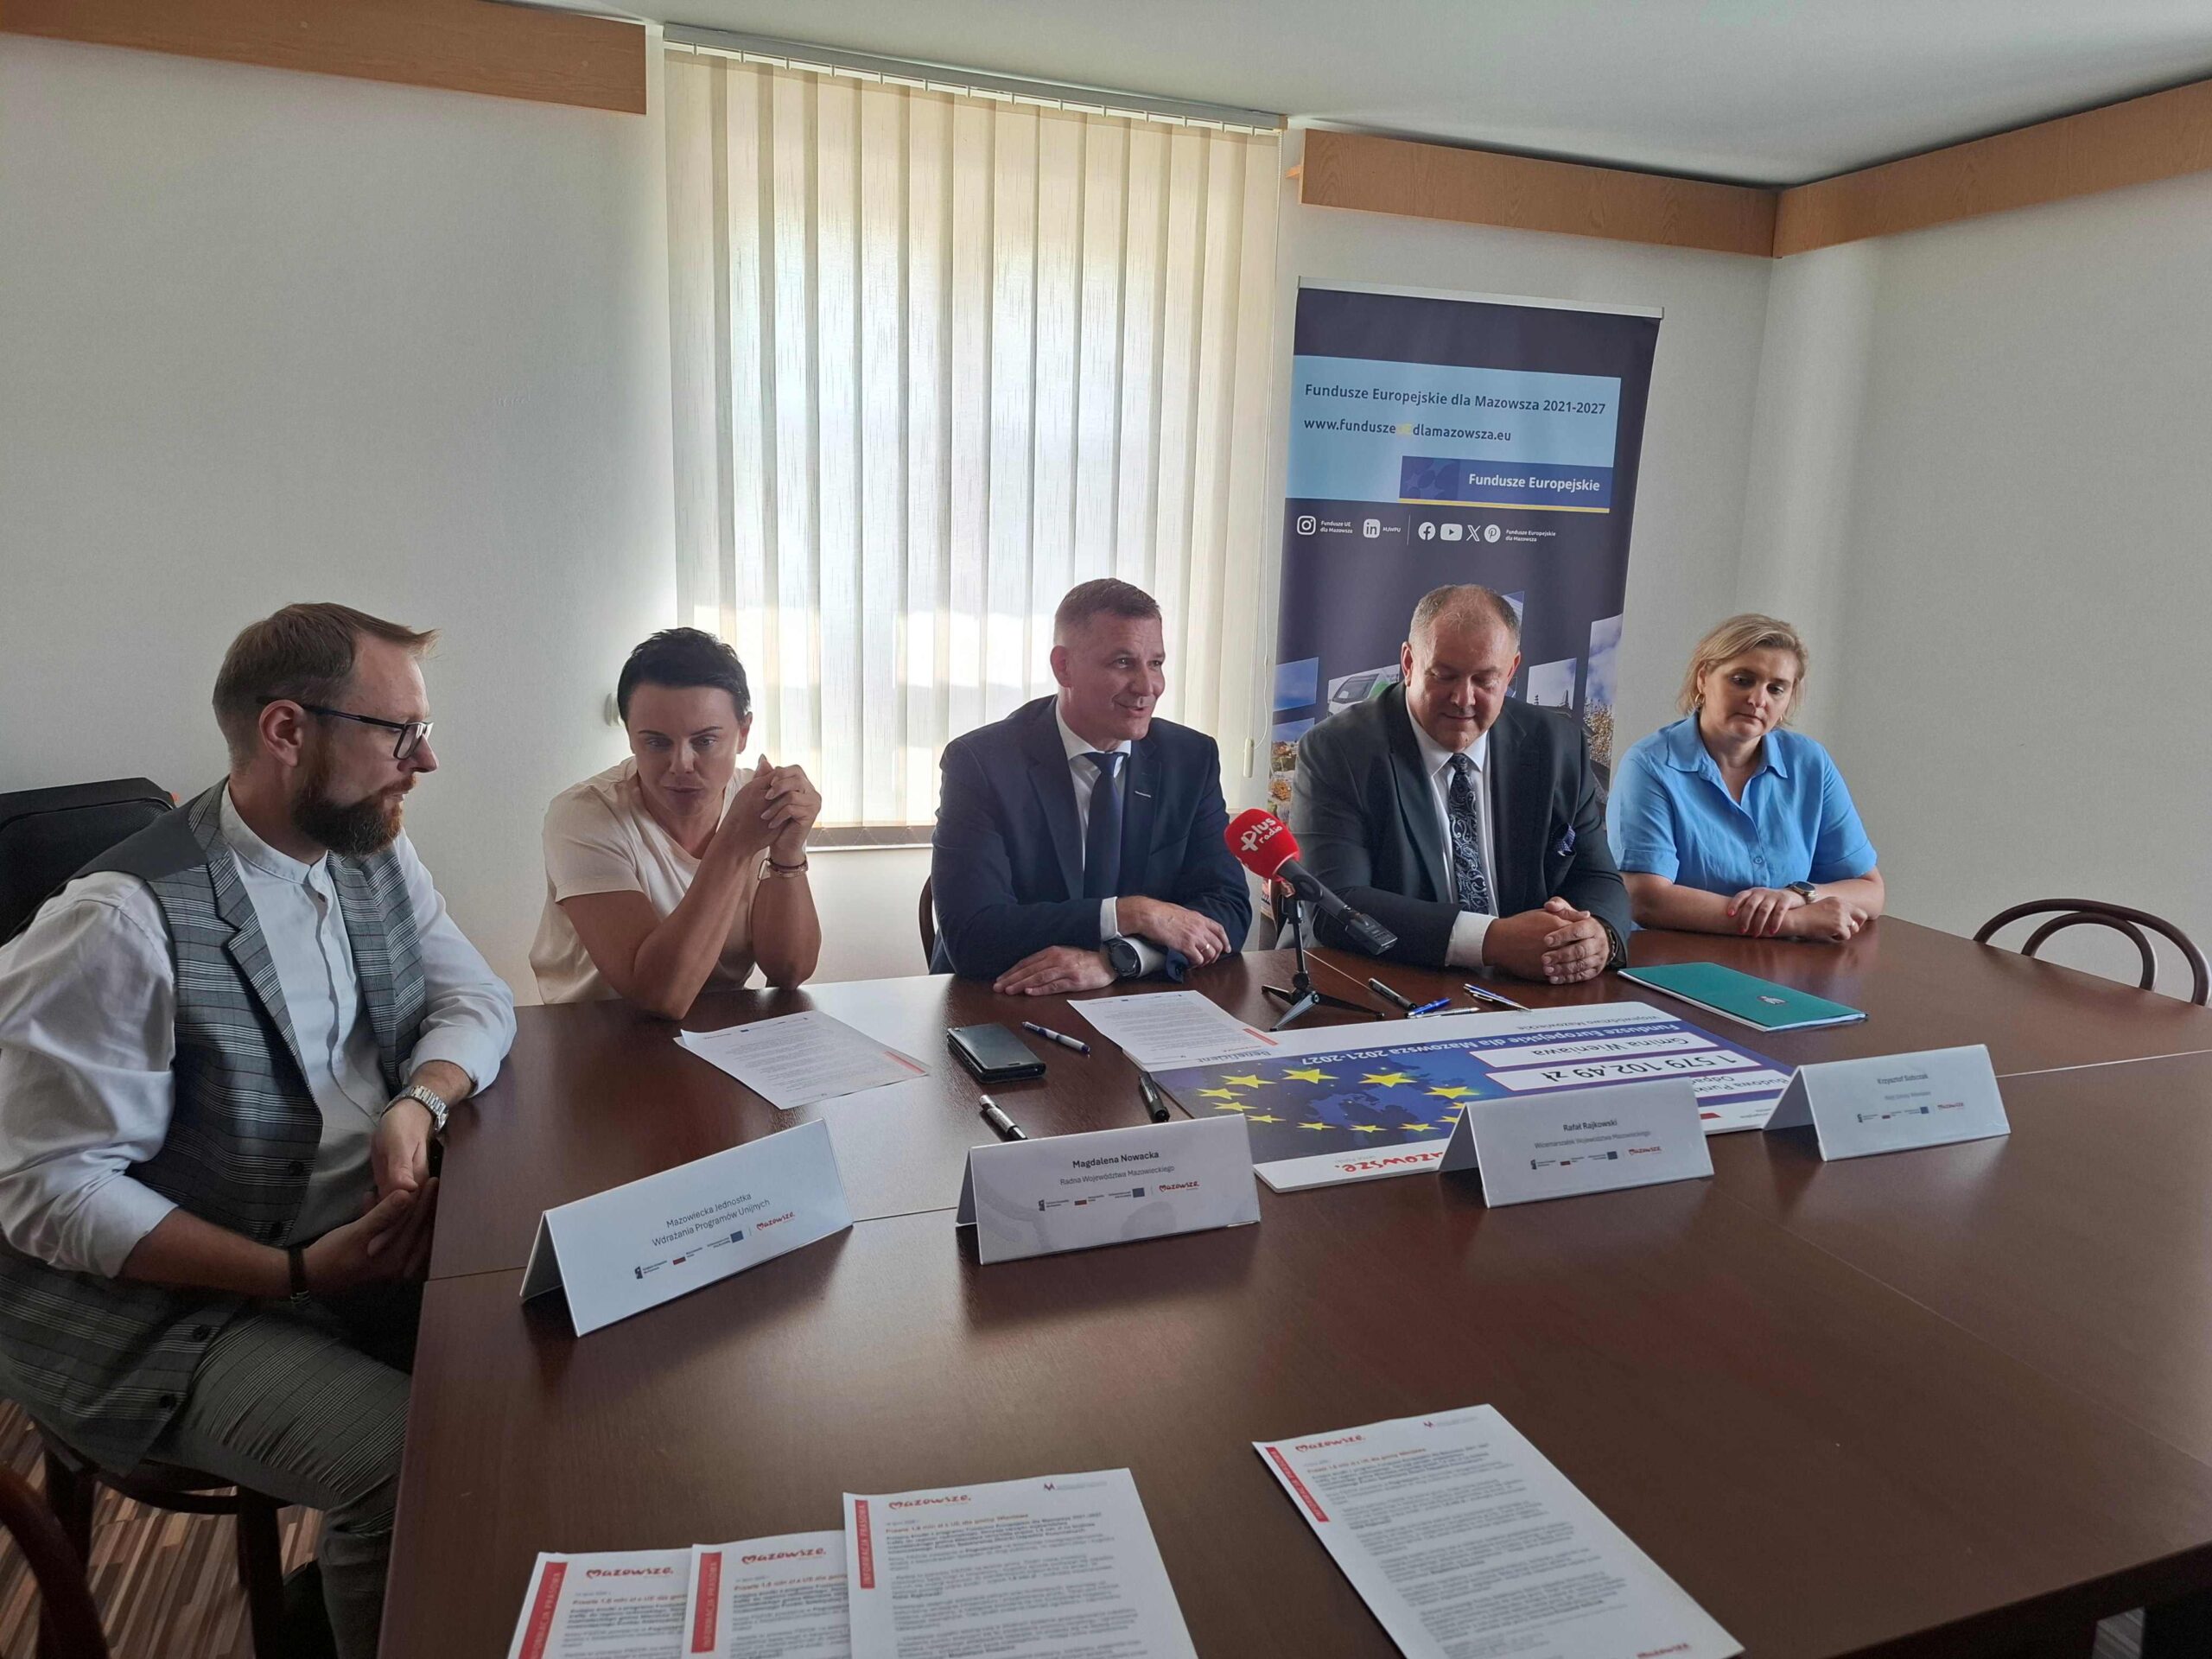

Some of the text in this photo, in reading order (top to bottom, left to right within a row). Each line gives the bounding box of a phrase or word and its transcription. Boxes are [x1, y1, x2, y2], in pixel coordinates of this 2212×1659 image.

[1305, 384, 1605, 415] Fundusze Europejskie dla Mazowsza 2021-2027
[1469, 474, 1600, 493] Fundusze Europejskie
[1259, 825, 1283, 843] radio
[1302, 1024, 1680, 1065] Fundusze Europejskie dla Mazowsza 2021-2027
[1532, 1037, 1688, 1055] Gmina Wieniawa
[1541, 1055, 1738, 1082] 1 579 102,49 zł
[1733, 1077, 1789, 1089] Budowa
[1563, 1118, 1618, 1132] Rafał Rajkowski
[1072, 1151, 1160, 1169] Magdalena Nowacka
[1060, 1165, 1175, 1185] Radna Województwa Mazowieckiego
[666, 1193, 752, 1228] Mazowiecka Jednostka
[652, 1198, 770, 1247] Wdrażania Programów Unijnych
